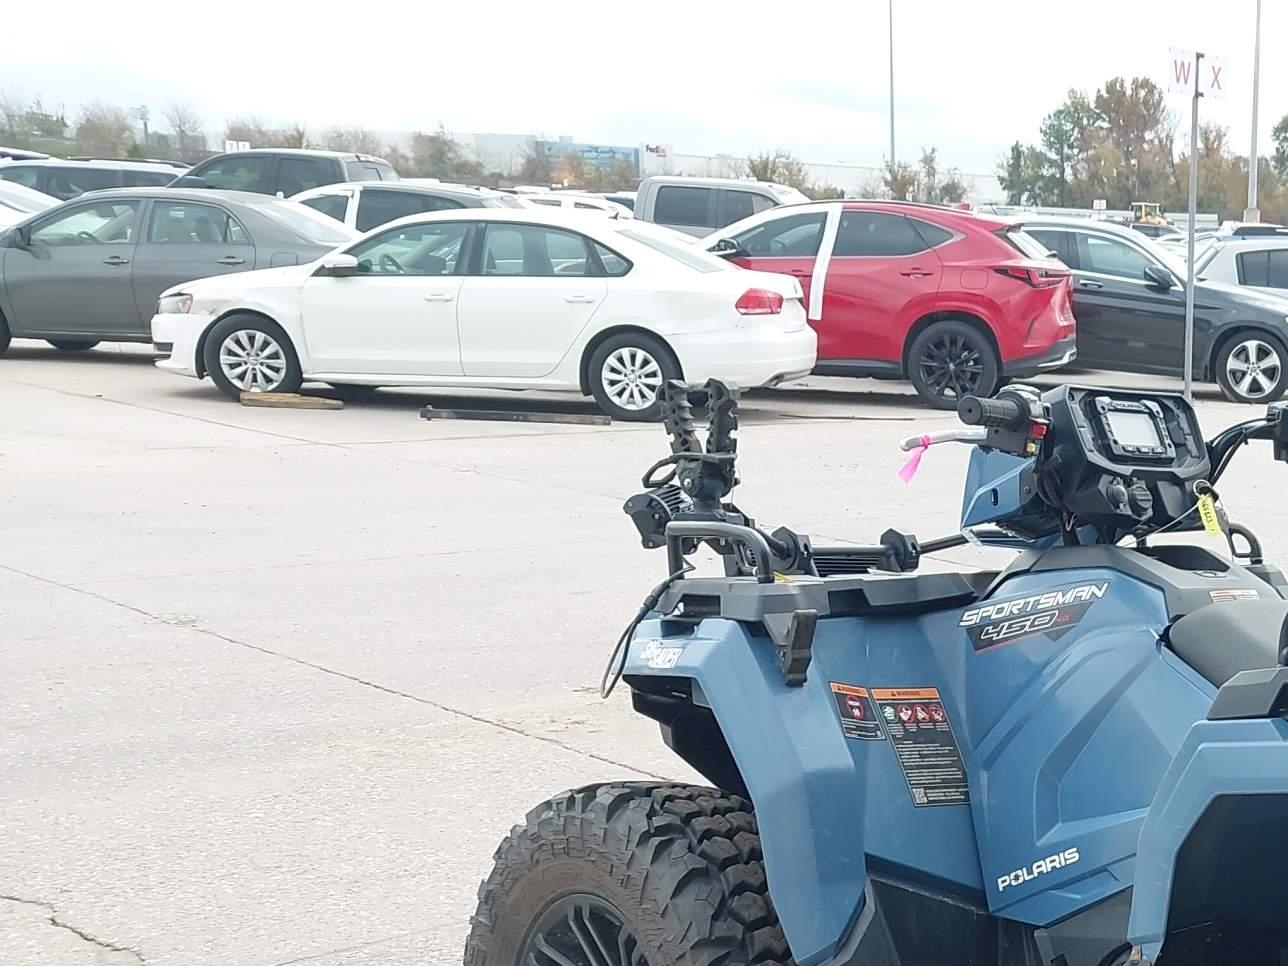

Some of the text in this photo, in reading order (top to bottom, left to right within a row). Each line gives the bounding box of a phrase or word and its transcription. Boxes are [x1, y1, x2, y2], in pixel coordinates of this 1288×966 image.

[1173, 59, 1192, 86] W
[1210, 65, 1222, 90] X
[958, 581, 1110, 627] SPORTSMAN
[980, 609, 1059, 641] 450
[997, 847, 1080, 892] POLARIS
